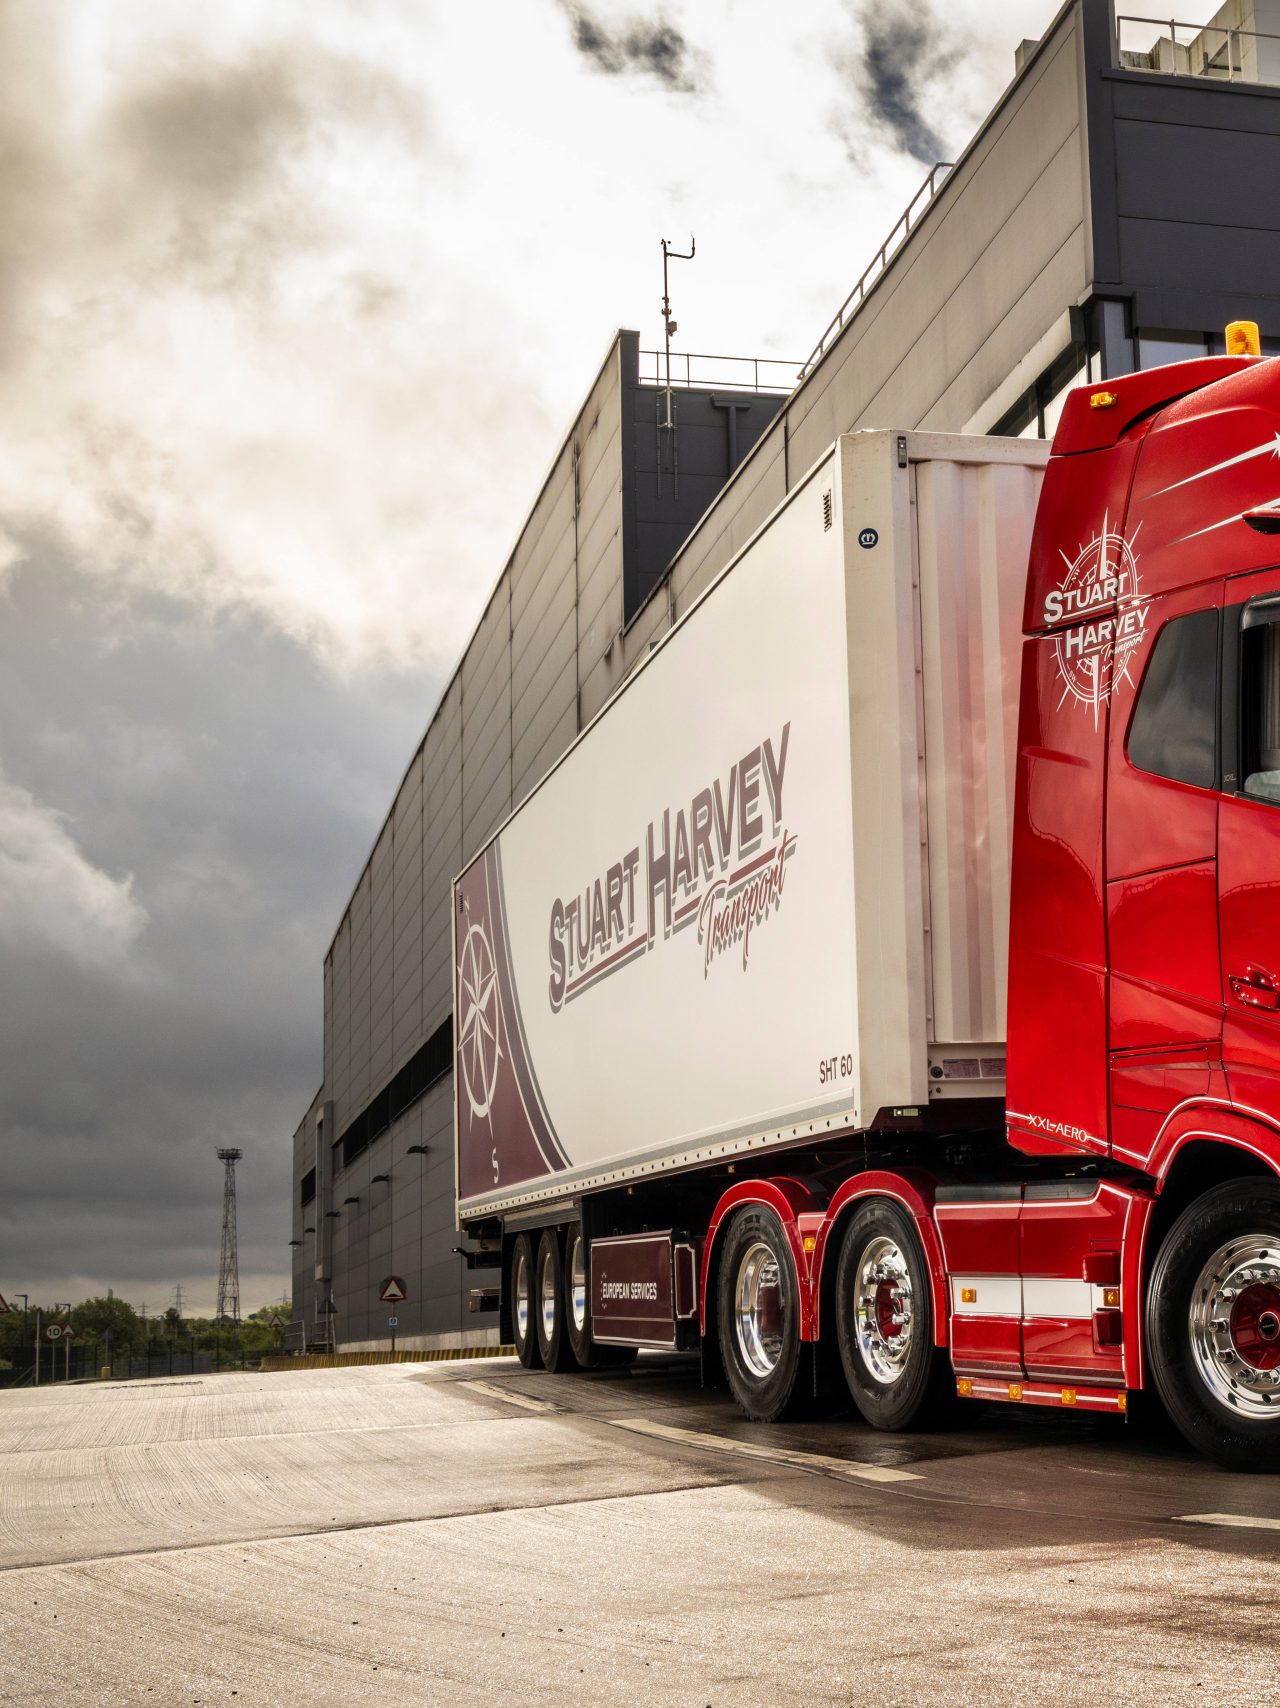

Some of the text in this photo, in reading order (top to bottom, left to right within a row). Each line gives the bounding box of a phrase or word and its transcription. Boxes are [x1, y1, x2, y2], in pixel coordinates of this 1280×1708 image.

[1043, 571, 1129, 624] STUART
[1065, 606, 1150, 659] HARVEY
[549, 721, 791, 1012] STUART HARVEY
[699, 829, 798, 976] Transport
[819, 1054, 853, 1085] SHT 60
[602, 1282, 658, 1300] EUROPEAN SERVICES
[48, 1328, 60, 1337] 10
